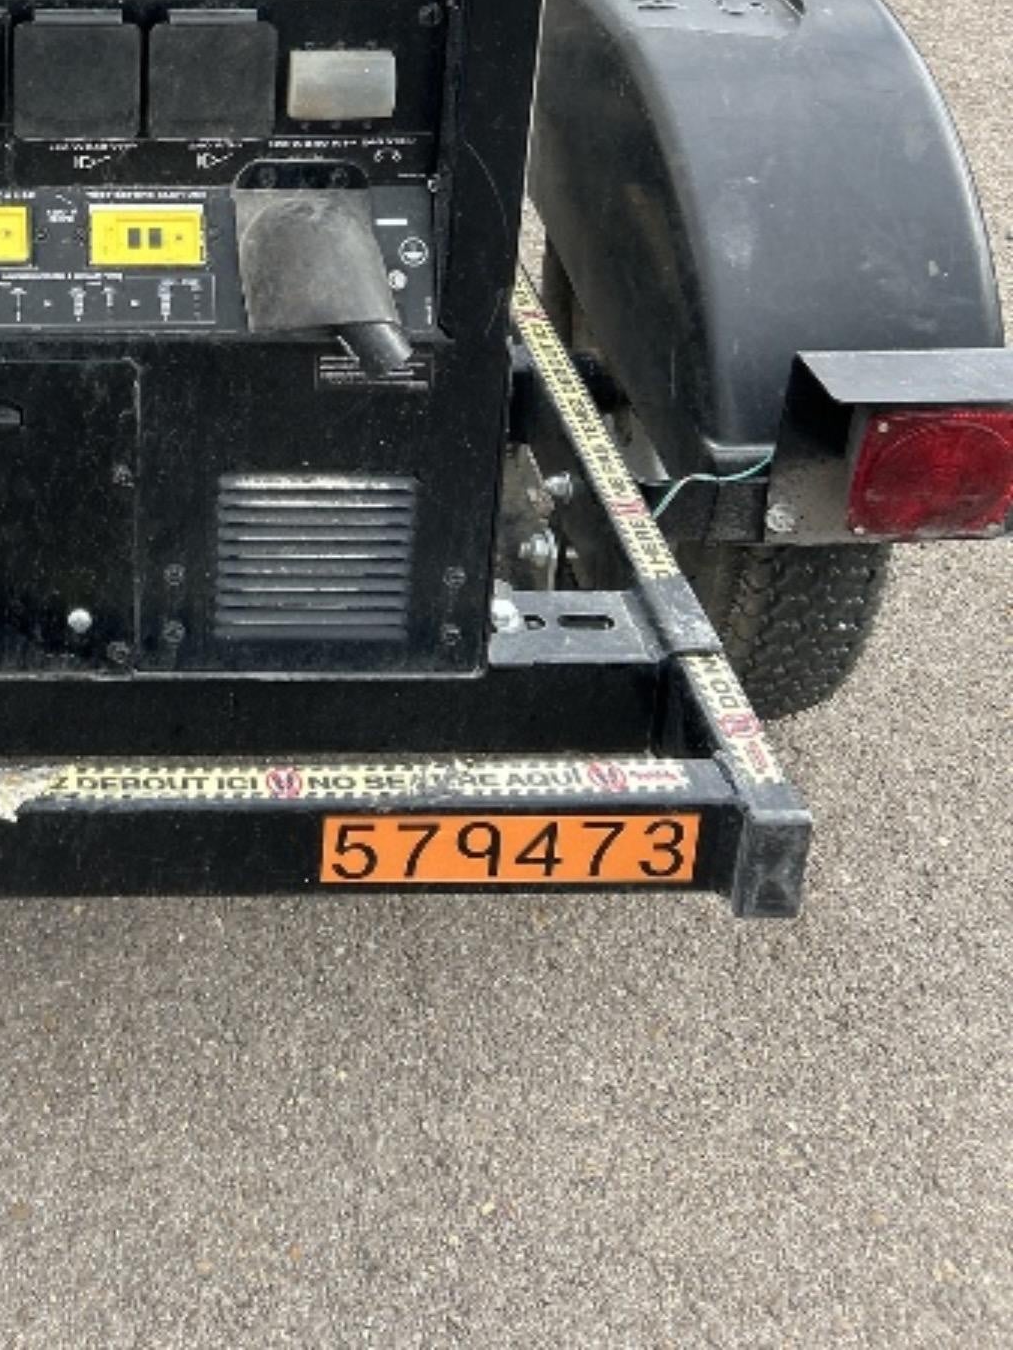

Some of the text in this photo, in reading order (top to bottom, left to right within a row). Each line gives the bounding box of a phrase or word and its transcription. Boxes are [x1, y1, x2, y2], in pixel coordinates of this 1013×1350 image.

[75, 775, 210, 791] DEBOUT
[217, 775, 258, 790] ICI
[306, 775, 357, 791] NO
[331, 818, 685, 881] 579473
